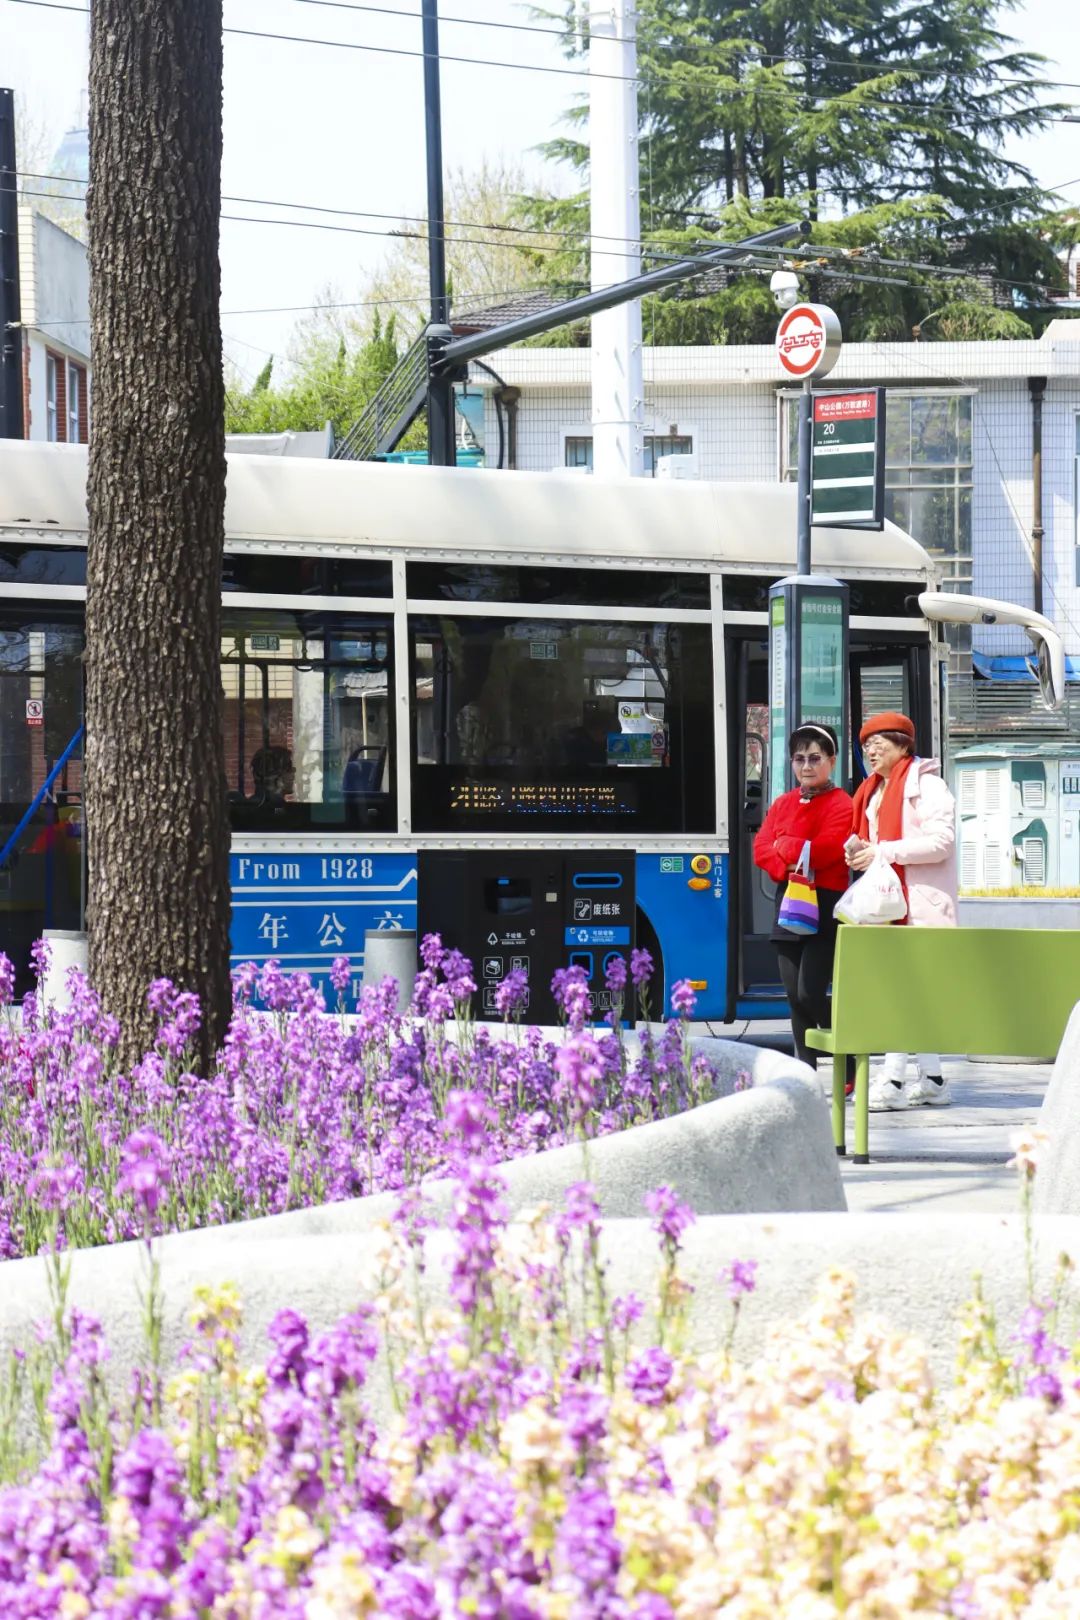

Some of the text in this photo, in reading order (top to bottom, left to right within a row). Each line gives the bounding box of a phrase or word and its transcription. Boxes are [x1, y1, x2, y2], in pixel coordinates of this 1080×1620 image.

[823, 423, 835, 435] 20
[238, 858, 373, 880] From 1928
[593, 903, 620, 916] 废纸张
